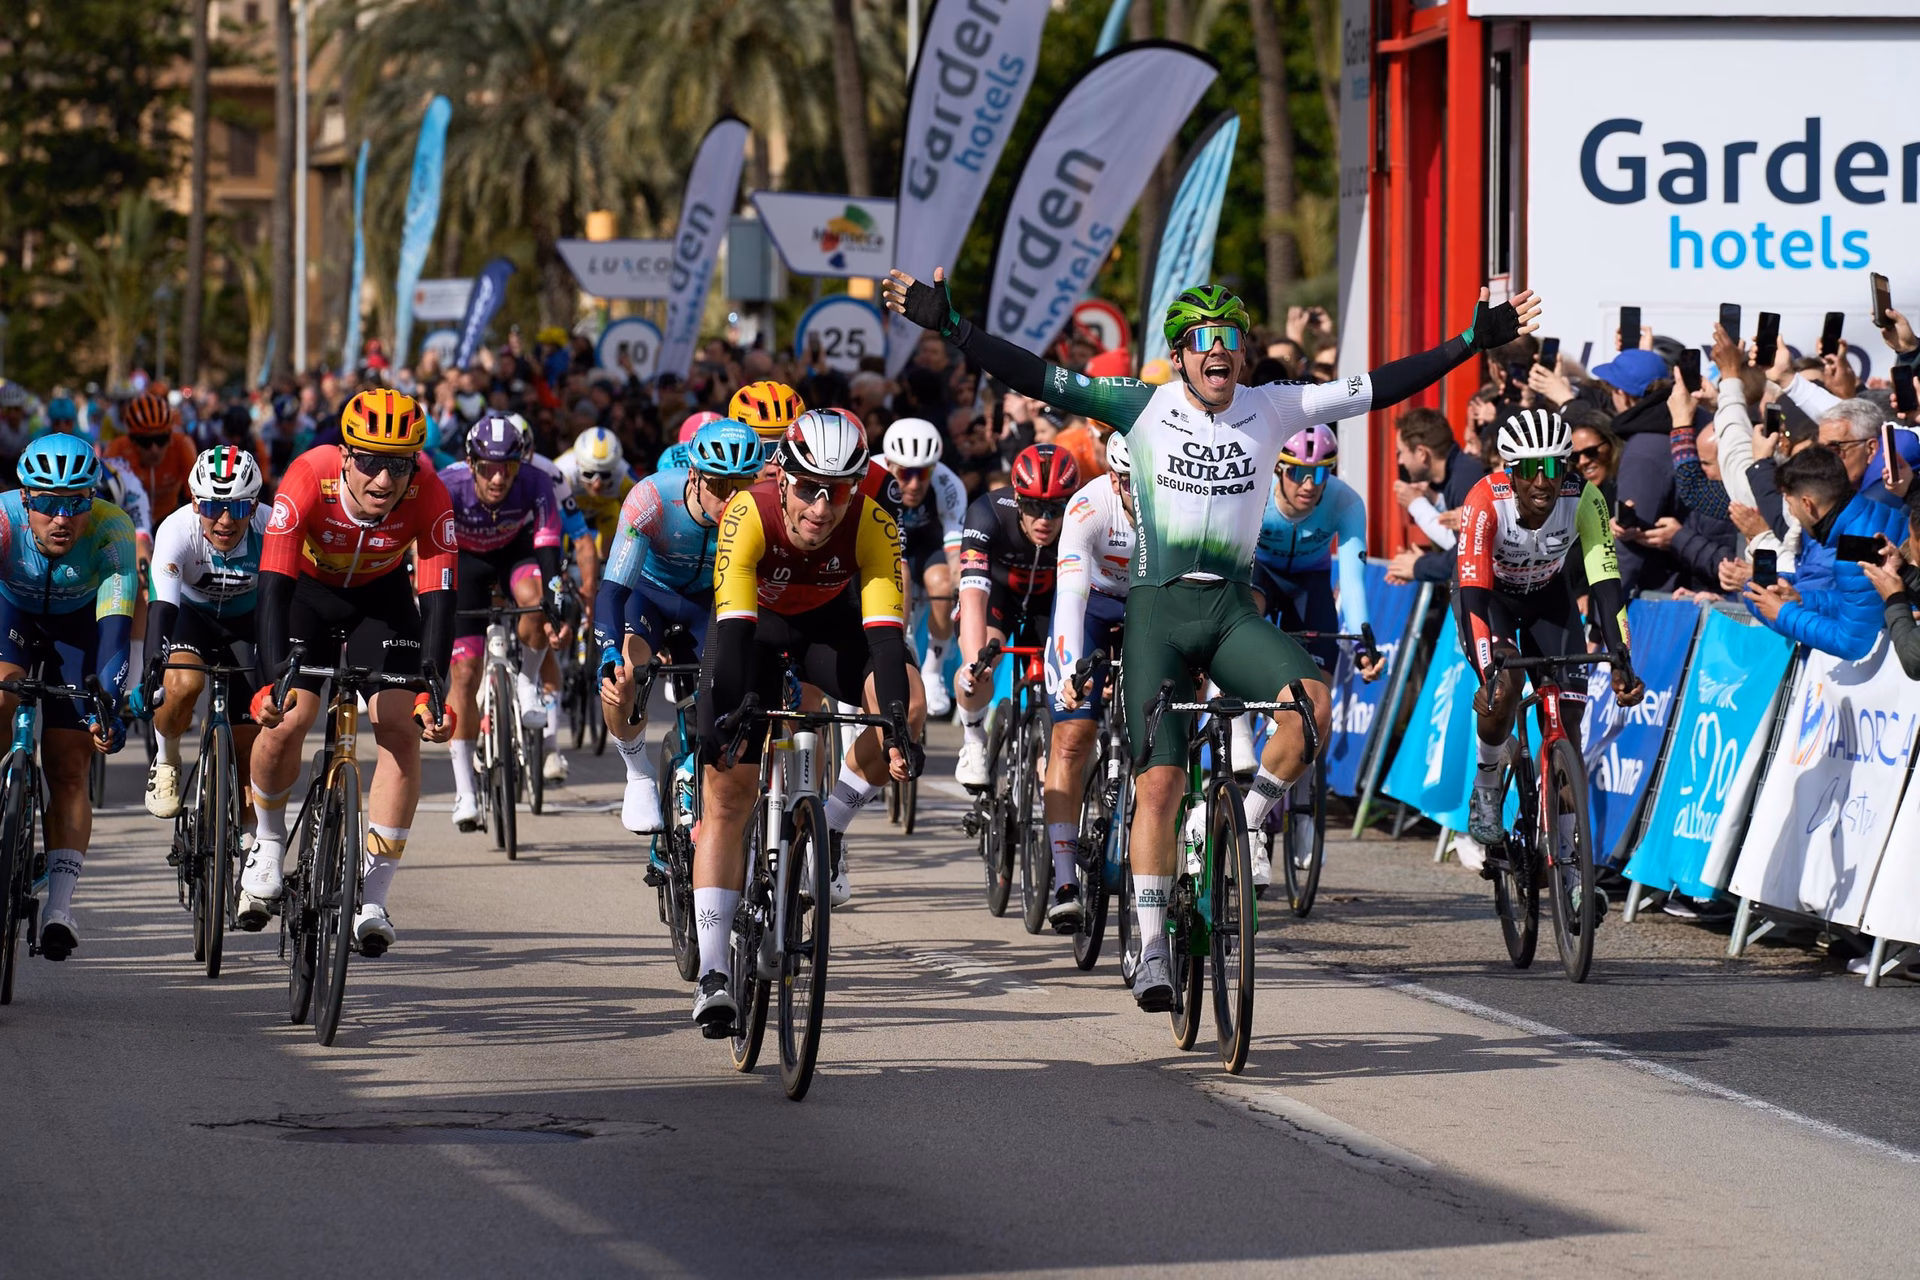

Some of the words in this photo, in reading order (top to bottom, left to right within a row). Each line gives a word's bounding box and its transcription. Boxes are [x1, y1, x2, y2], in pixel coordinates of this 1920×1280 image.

[953, 52, 1026, 173] hotels
[997, 148, 1106, 335] arden
[1669, 214, 1871, 269] hotels
[1167, 454, 1257, 481] RURAL
[1182, 441, 1247, 463] CAJA
[1156, 473, 1210, 497] SEGUROS
[1211, 479, 1255, 497] RGA
[714, 503, 749, 593] Cofidis
[963, 528, 991, 543] BMC
[1137, 526, 1148, 577] SEGUROS
[1473, 509, 1488, 556] TECHNORD
[1171, 702, 1209, 710] Vision
[1243, 701, 1282, 709] Vision
[1596, 742, 1645, 796] alma
[1142, 888, 1165, 897] CAJA
